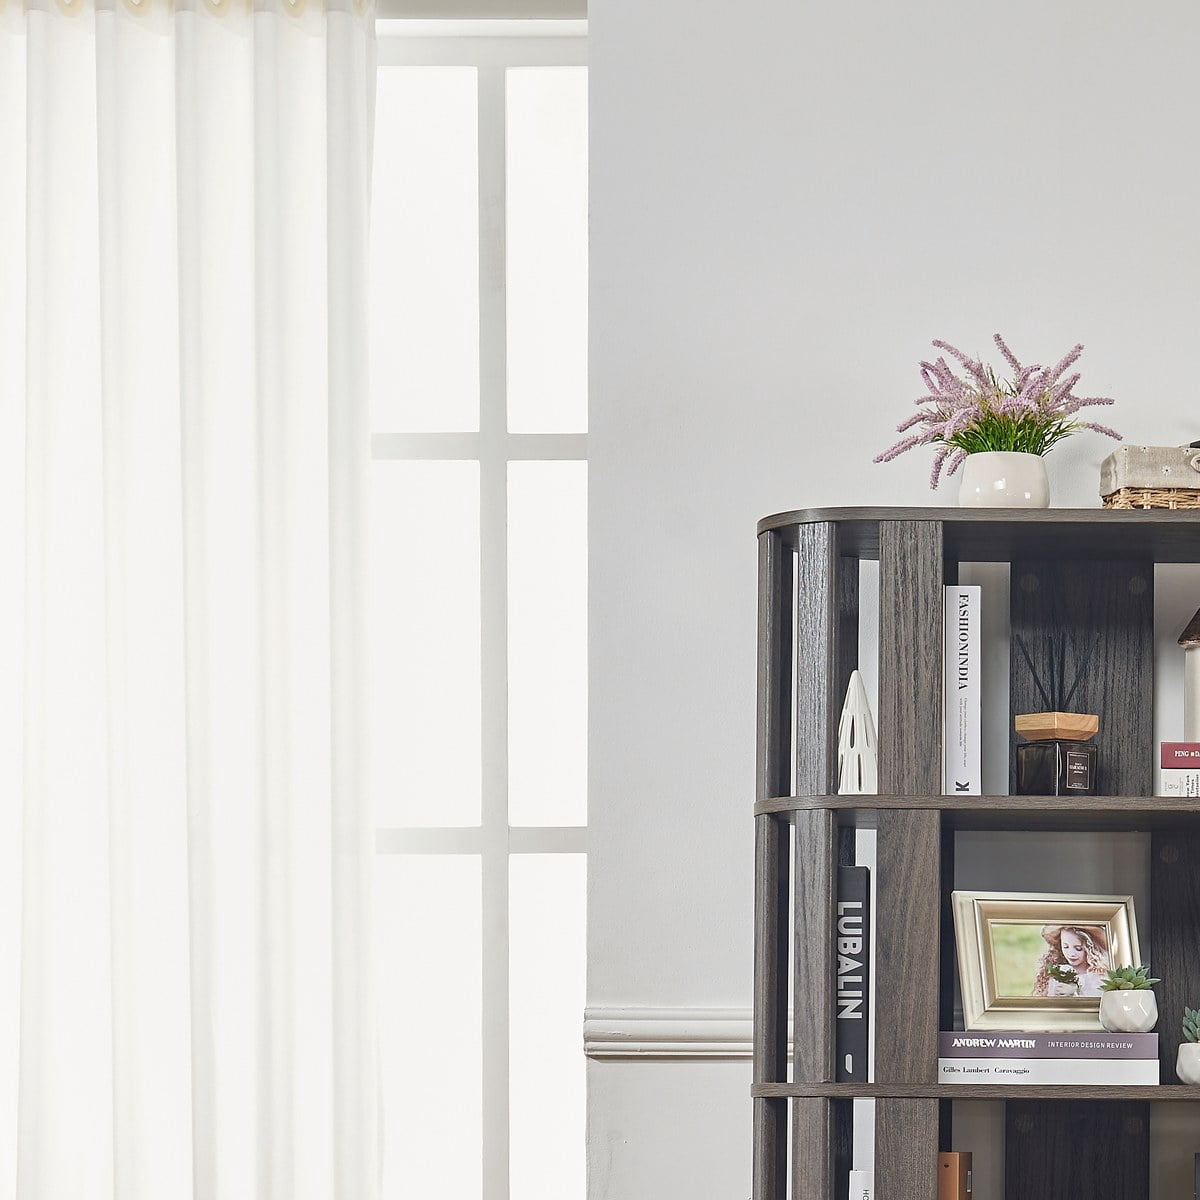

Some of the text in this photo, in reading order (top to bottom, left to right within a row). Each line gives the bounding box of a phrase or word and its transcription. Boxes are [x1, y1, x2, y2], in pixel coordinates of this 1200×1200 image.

[959, 594, 969, 691] FASHIONINDIA
[955, 781, 970, 792] K
[837, 901, 863, 1019] LUBALIN
[951, 1038, 1036, 1049] ANDREW MARTIN
